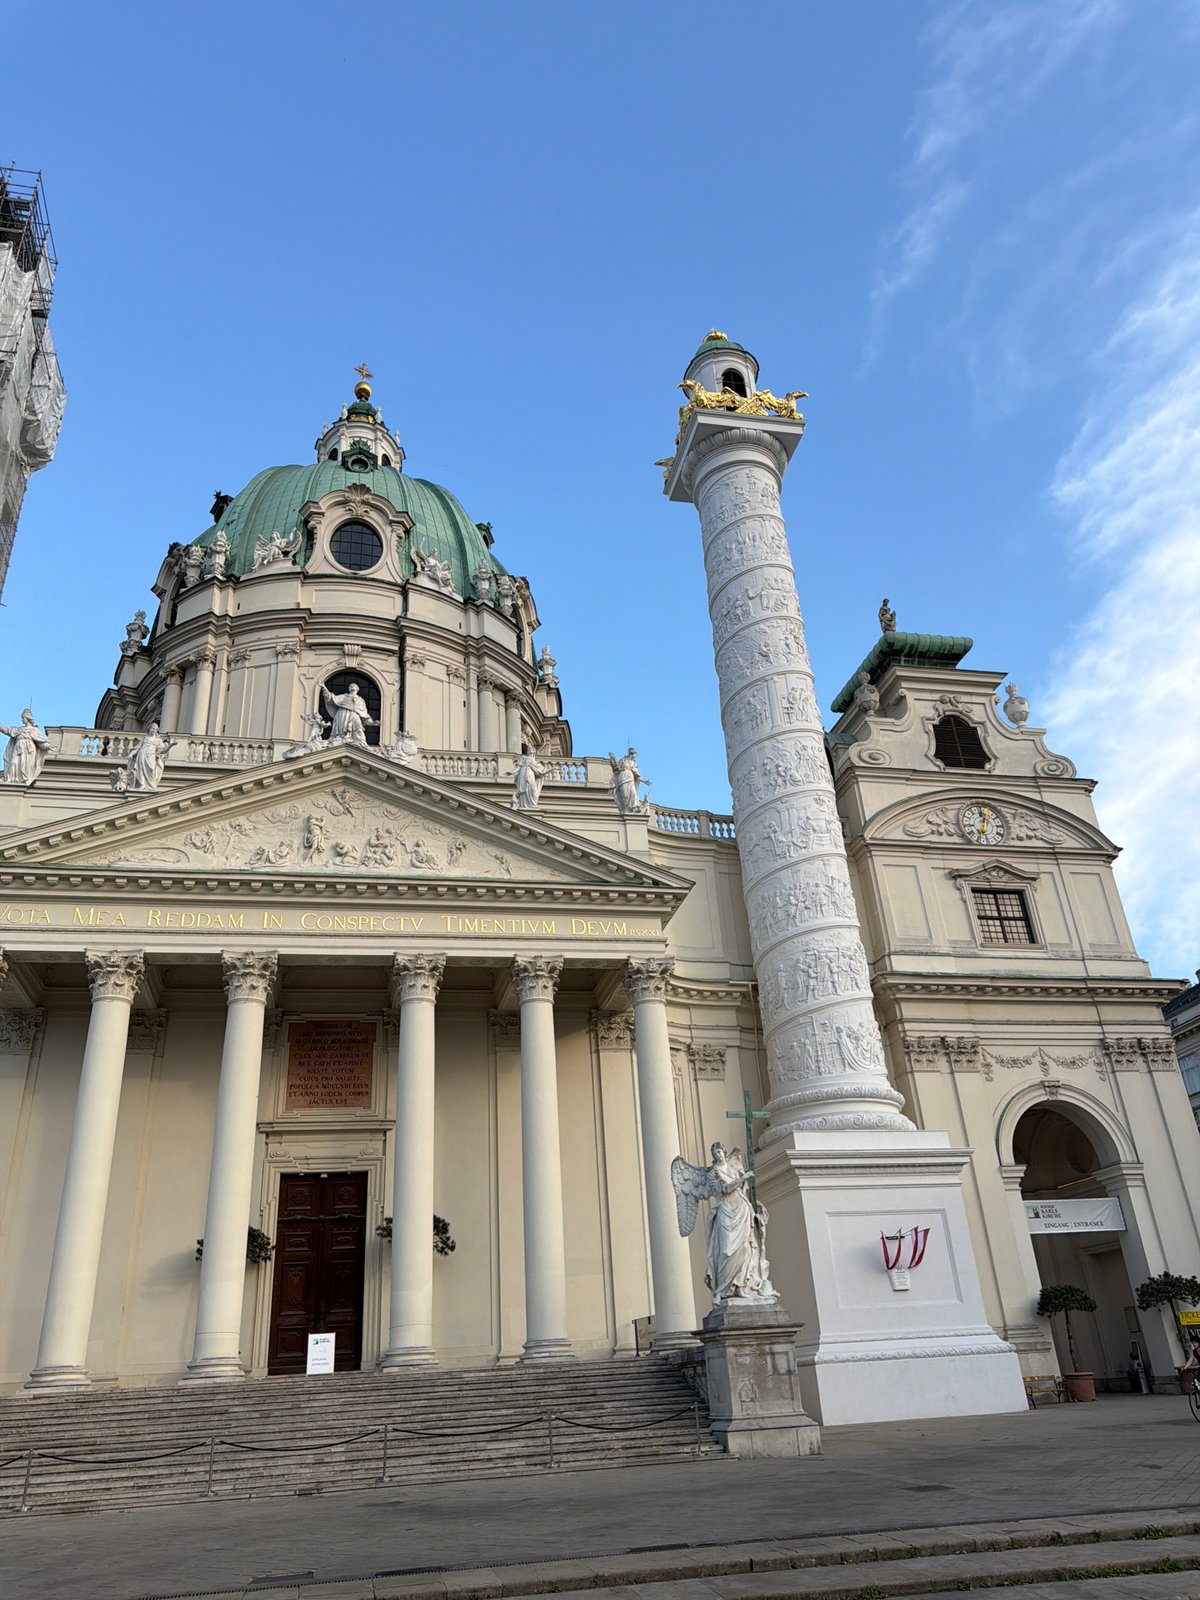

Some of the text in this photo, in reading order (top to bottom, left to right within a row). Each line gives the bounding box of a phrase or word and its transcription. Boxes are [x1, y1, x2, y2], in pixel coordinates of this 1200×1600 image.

[73, 907, 126, 926] MEA
[147, 909, 245, 929] REDDAM
[263, 911, 283, 929] IN
[300, 912, 424, 932] CONSPECTV
[440, 915, 556, 934] TIMENTIVM
[571, 918, 627, 936] DEVM
